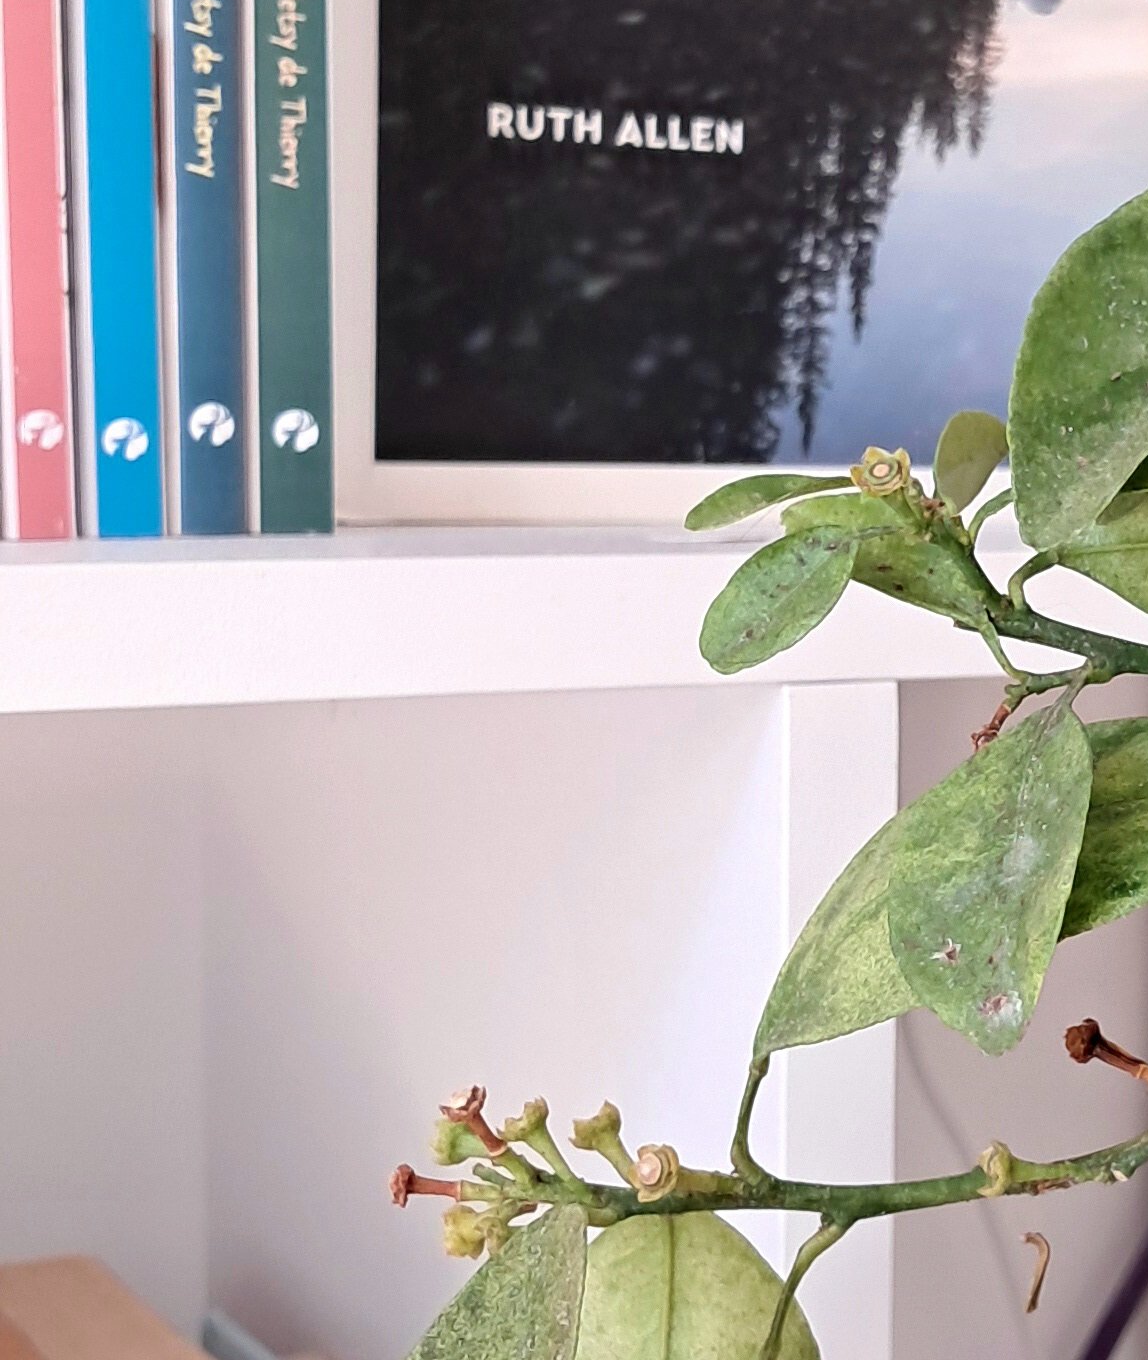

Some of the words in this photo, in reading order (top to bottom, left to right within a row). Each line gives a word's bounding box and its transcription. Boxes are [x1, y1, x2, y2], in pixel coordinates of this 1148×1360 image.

[193, 44, 223, 75] de
[278, 57, 308, 87] de
[186, 86, 221, 178] Thierry
[271, 97, 307, 188] Thierry
[487, 101, 602, 145] RUTH
[615, 111, 744, 154] ALLEN
